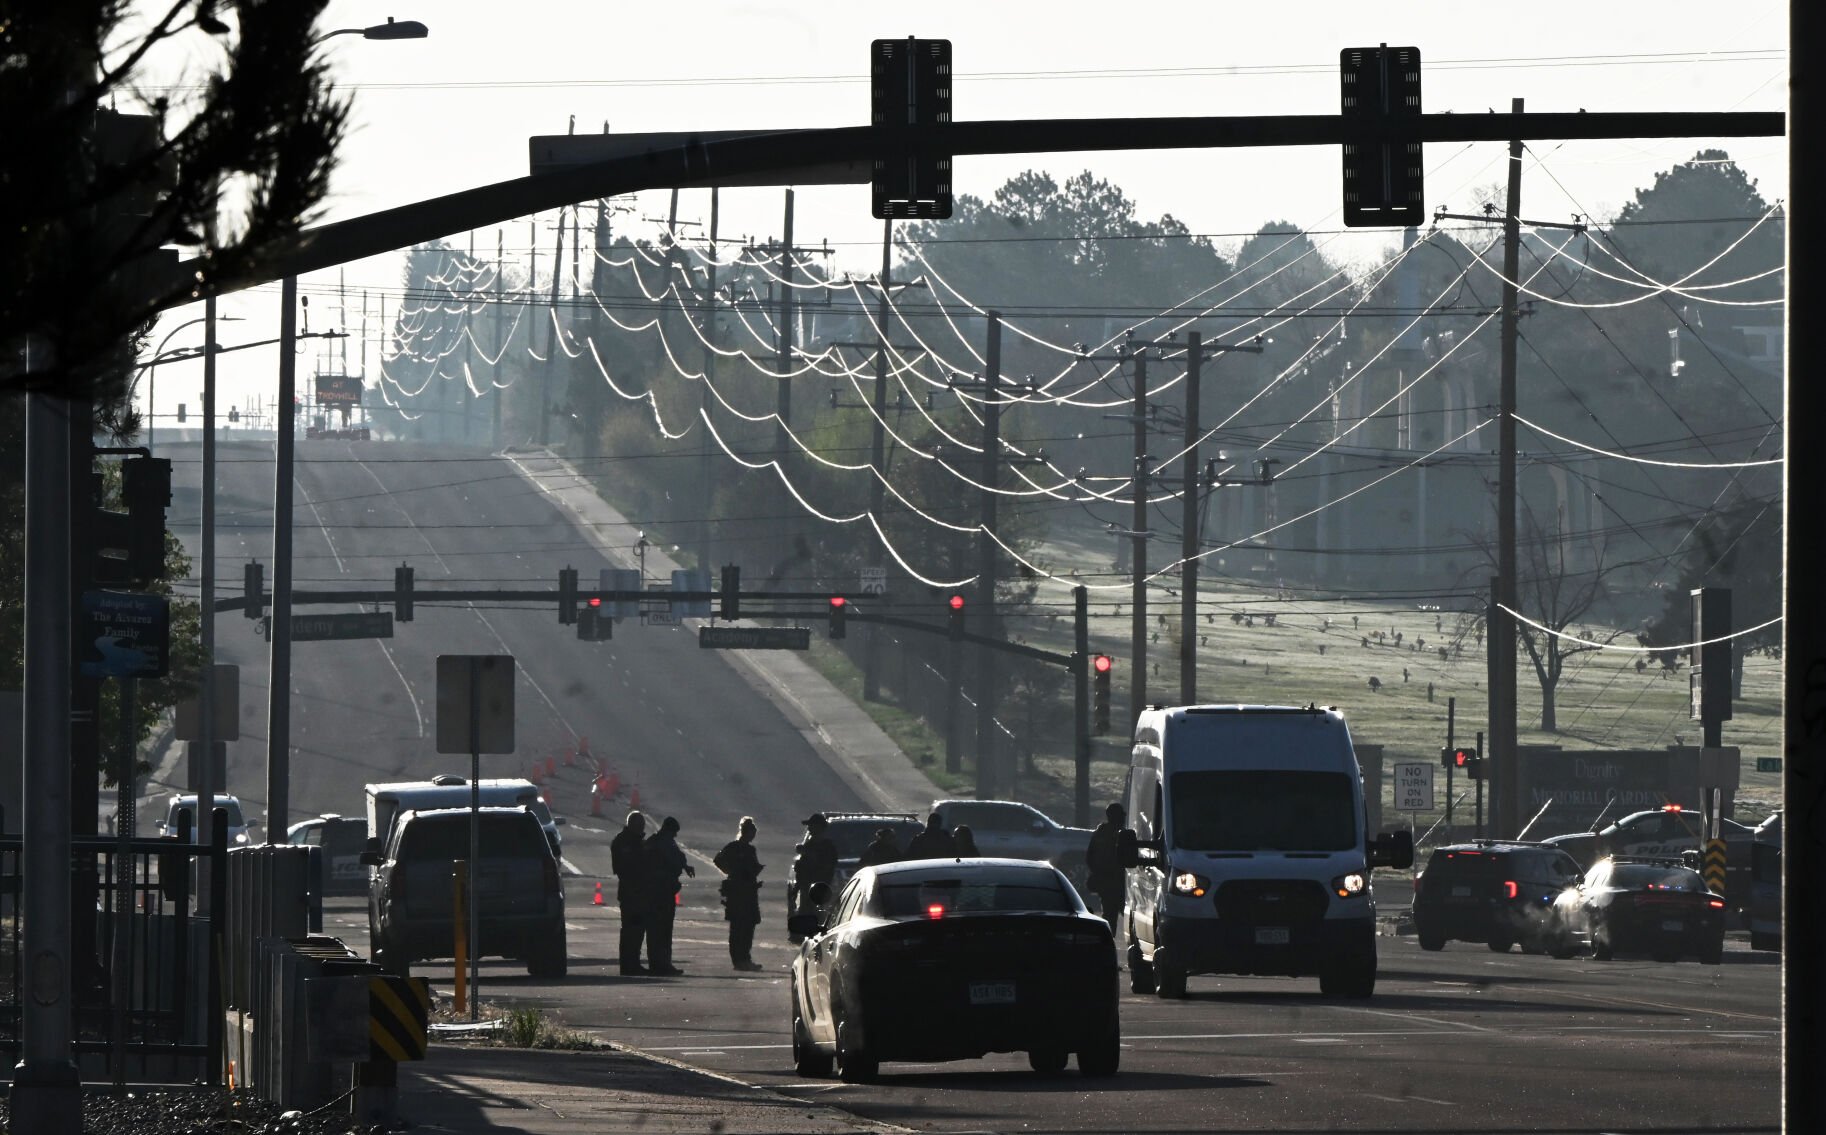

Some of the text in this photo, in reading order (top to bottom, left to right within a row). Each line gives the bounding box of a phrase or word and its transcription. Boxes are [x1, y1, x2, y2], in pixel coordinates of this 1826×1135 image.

[862, 569, 885, 577] SPEED
[863, 583, 884, 593] 40
[100, 599, 133, 610] Adopted
[92, 611, 152, 624] The Alvarez
[104, 626, 141, 640] Family
[1405, 767, 1422, 777] NO
[1575, 759, 1620, 782] Dignity
[1400, 778, 1427, 787] TURN
[1407, 788, 1421, 797] ON
[1532, 787, 1667, 805] MEMORIAL GARDENS
[1404, 798, 1424, 807] RED
